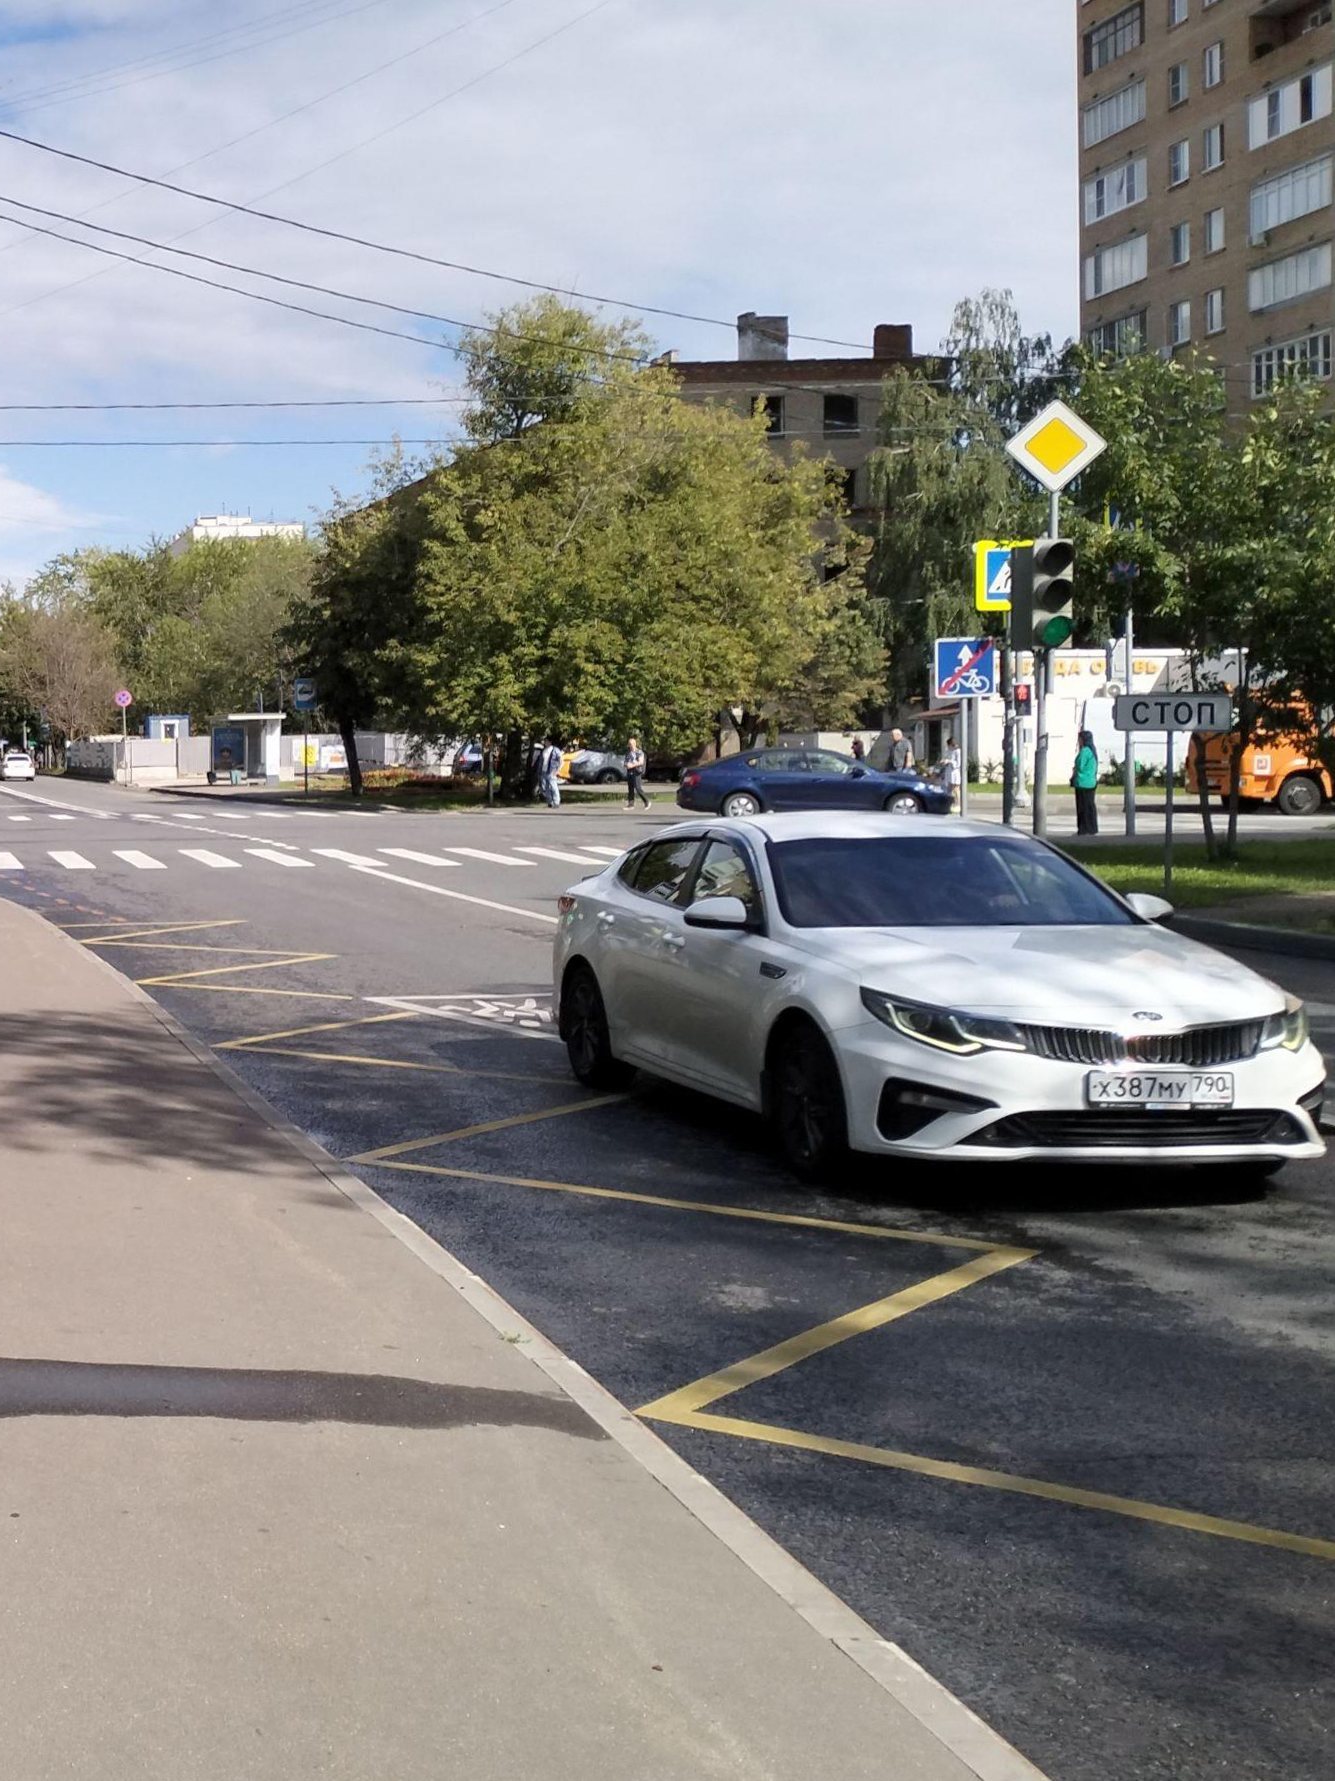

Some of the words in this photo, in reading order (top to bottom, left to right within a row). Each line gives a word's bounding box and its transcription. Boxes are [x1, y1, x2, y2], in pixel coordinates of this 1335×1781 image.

[1131, 702, 1216, 726] СТОП
[1097, 1077, 1188, 1099] Х387МУ
[1193, 1076, 1227, 1092] 790
